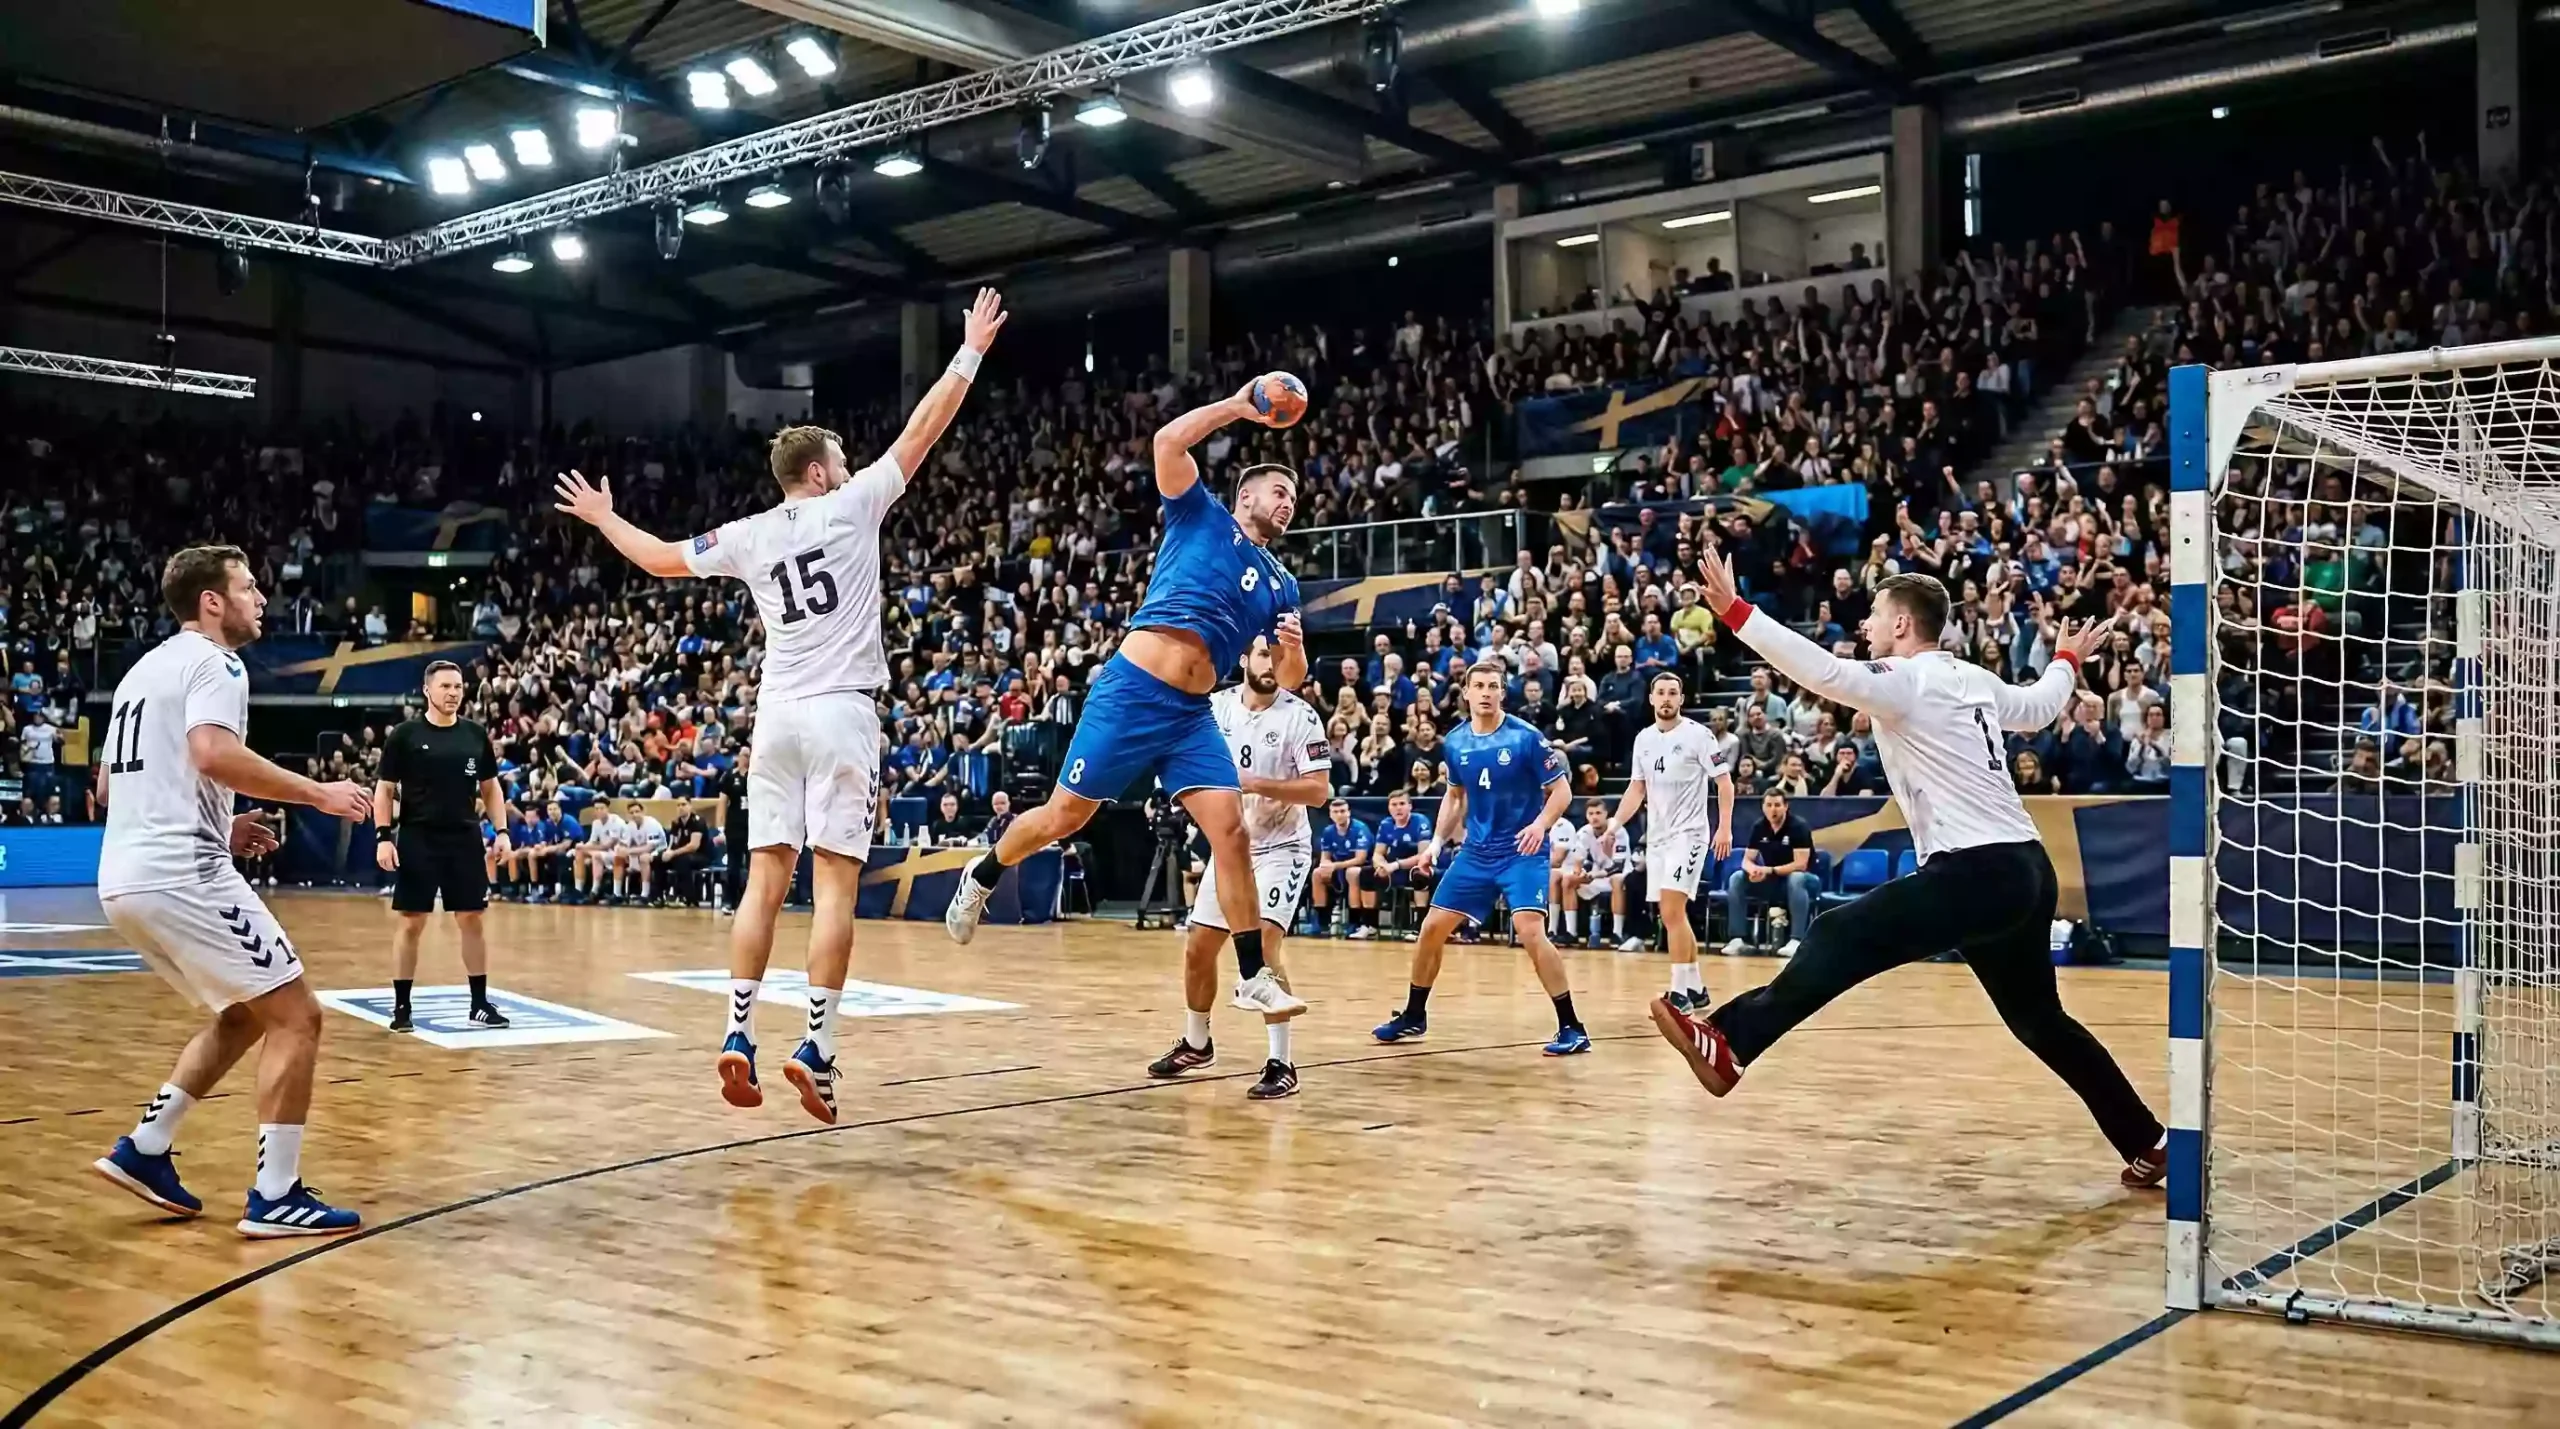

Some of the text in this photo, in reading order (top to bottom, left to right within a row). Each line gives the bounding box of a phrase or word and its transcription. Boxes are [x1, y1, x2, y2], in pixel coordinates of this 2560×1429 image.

[770, 548, 838, 625] 15
[1240, 566, 1259, 592] 8
[110, 697, 145, 774] 11
[1974, 707, 2003, 771] 1
[1240, 744, 1252, 769] 8
[1068, 757, 1086, 785] 8
[1478, 767, 1492, 790] 4
[1673, 865, 1682, 883] 4
[1267, 886, 1281, 909] 9
